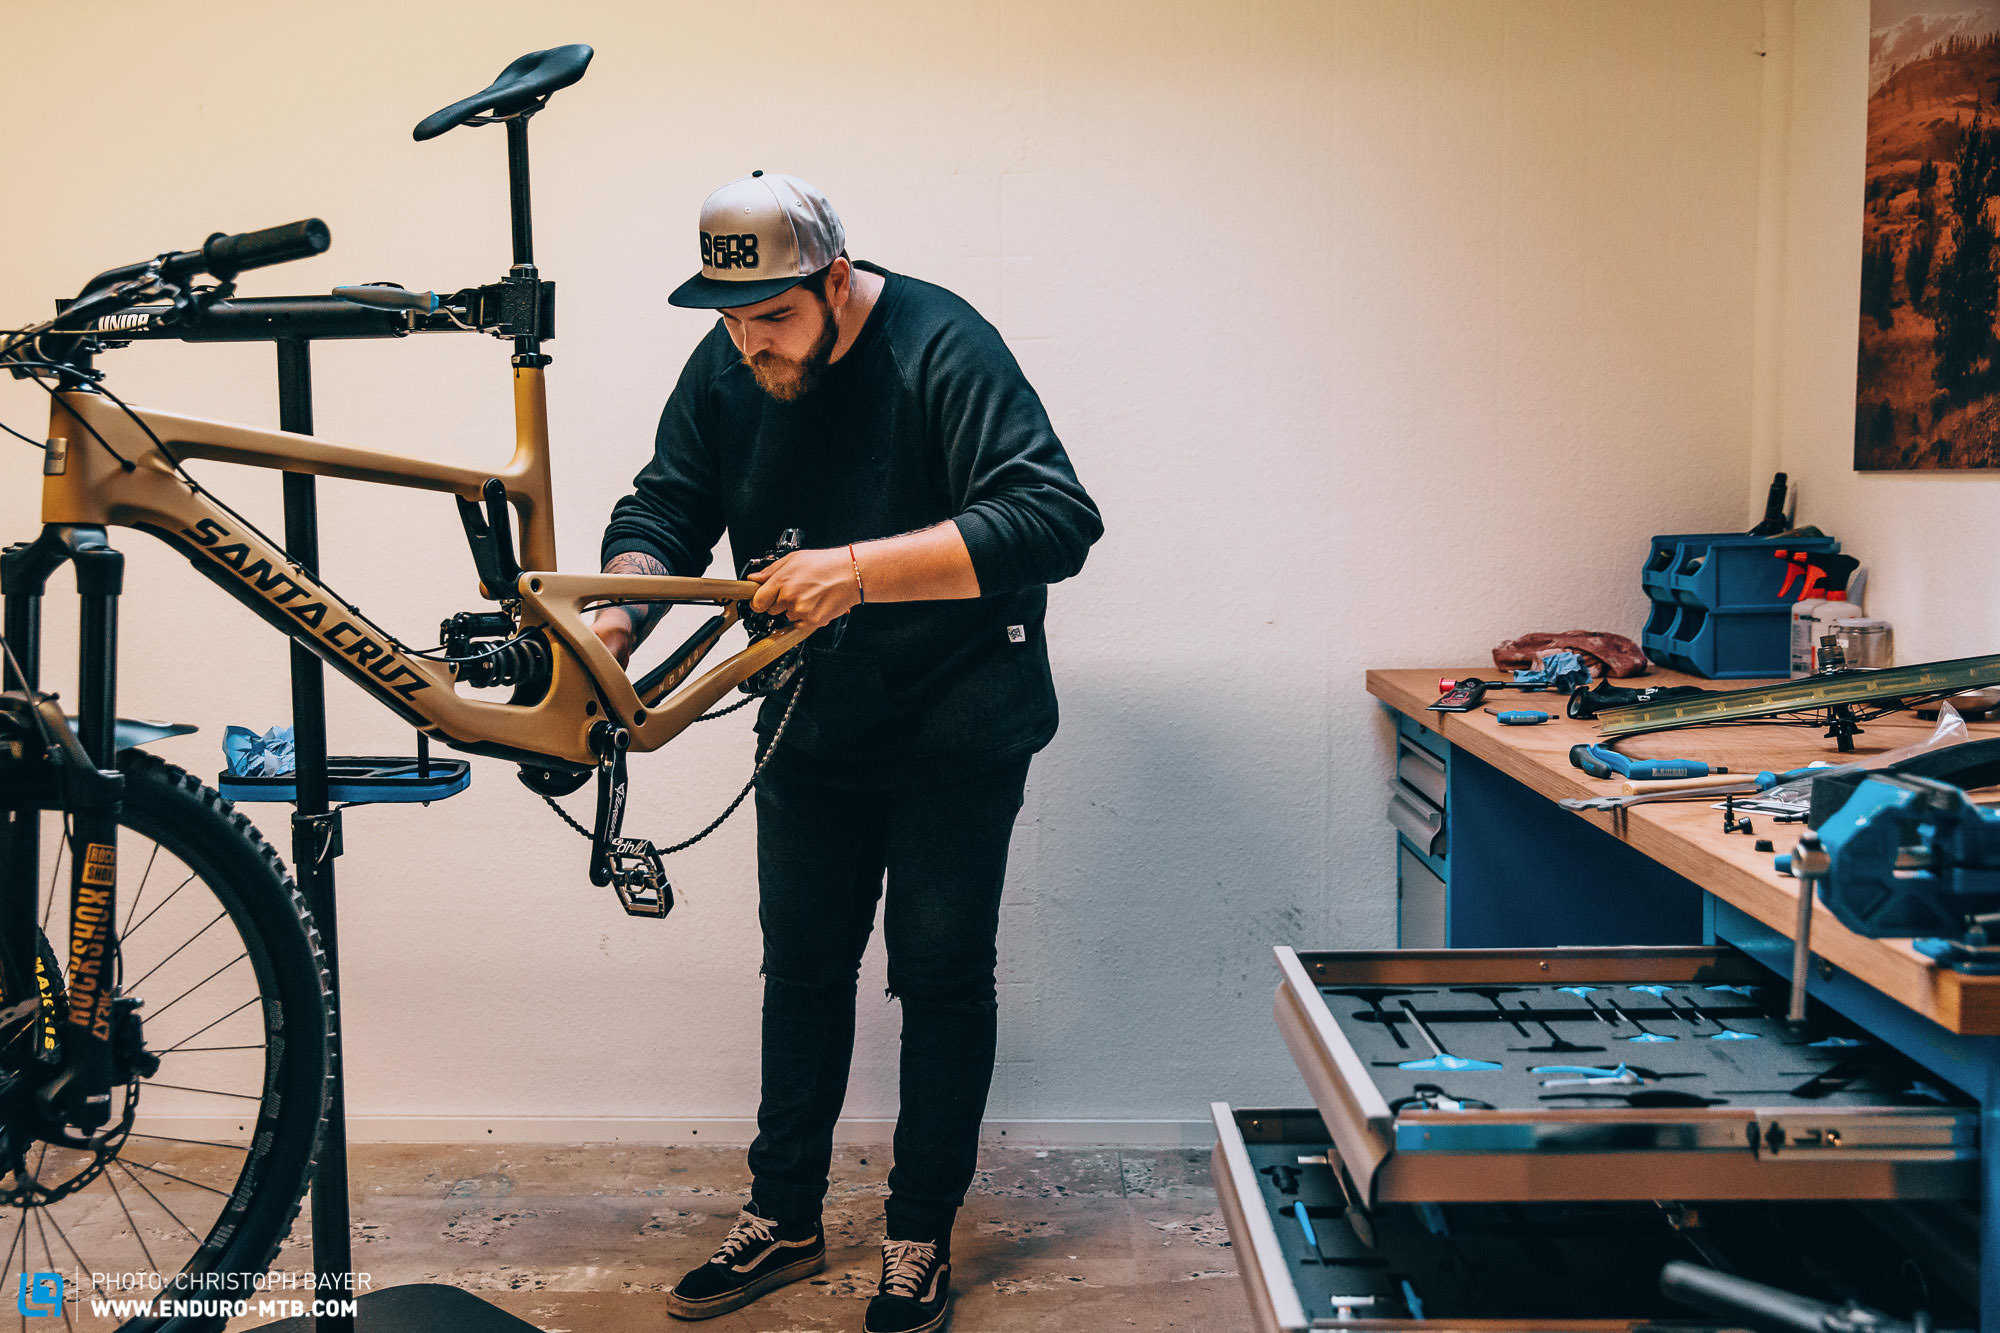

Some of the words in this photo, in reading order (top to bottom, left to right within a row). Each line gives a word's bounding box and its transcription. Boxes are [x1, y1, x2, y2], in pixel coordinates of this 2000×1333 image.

[713, 250, 759, 270] URO
[180, 518, 328, 629] SANTA
[322, 621, 432, 702] CRUZ
[34, 956, 56, 1050] MAXIS
[69, 887, 111, 1026] ROCKSHOX
